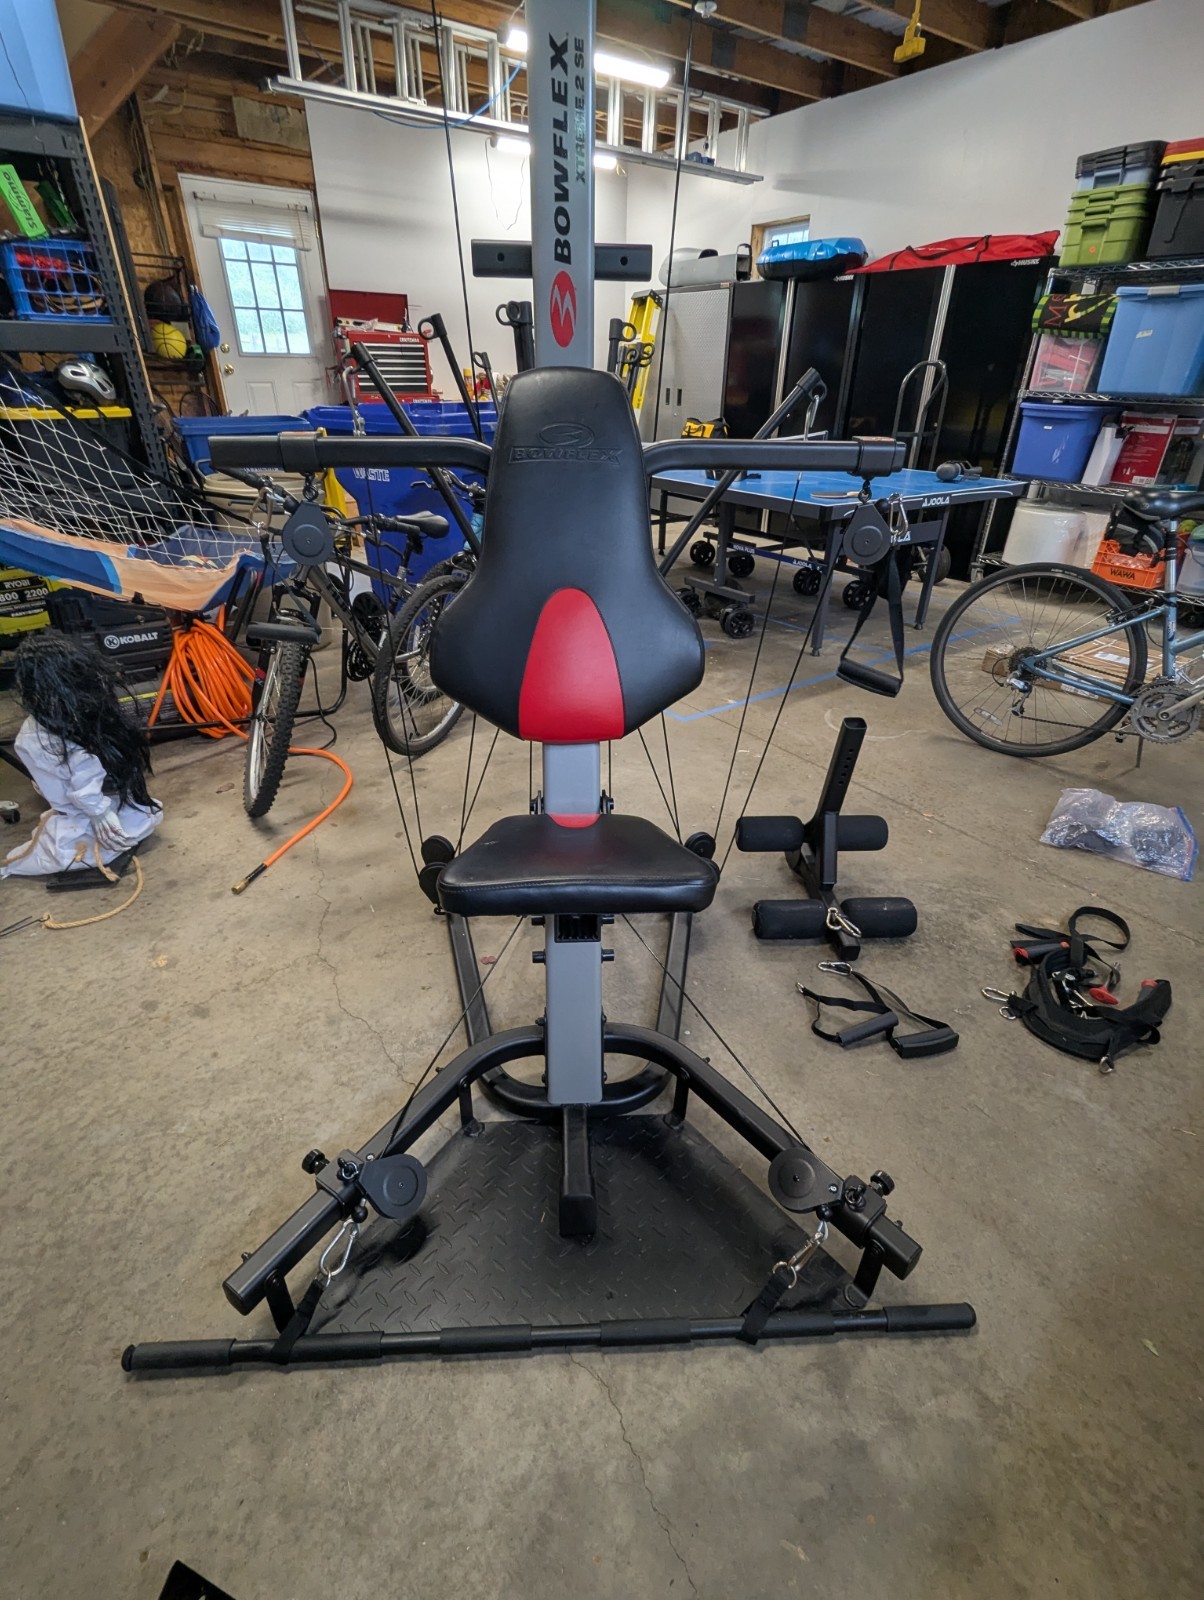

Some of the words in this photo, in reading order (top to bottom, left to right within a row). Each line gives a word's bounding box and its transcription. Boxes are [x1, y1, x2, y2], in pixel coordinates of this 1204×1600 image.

[574, 37, 585, 69] SE
[574, 75, 585, 92] 2
[549, 32, 571, 265] BOWFLEX
[514, 448, 622, 461] BOWFLEX
[352, 467, 390, 482] WSTE
[927, 497, 950, 506] JOOLA
[1110, 568, 1136, 580] WAWA
[4, 579, 31, 589] RYOBI
[24, 587, 49, 598] 2200
[120, 632, 158, 644] KOBALT
